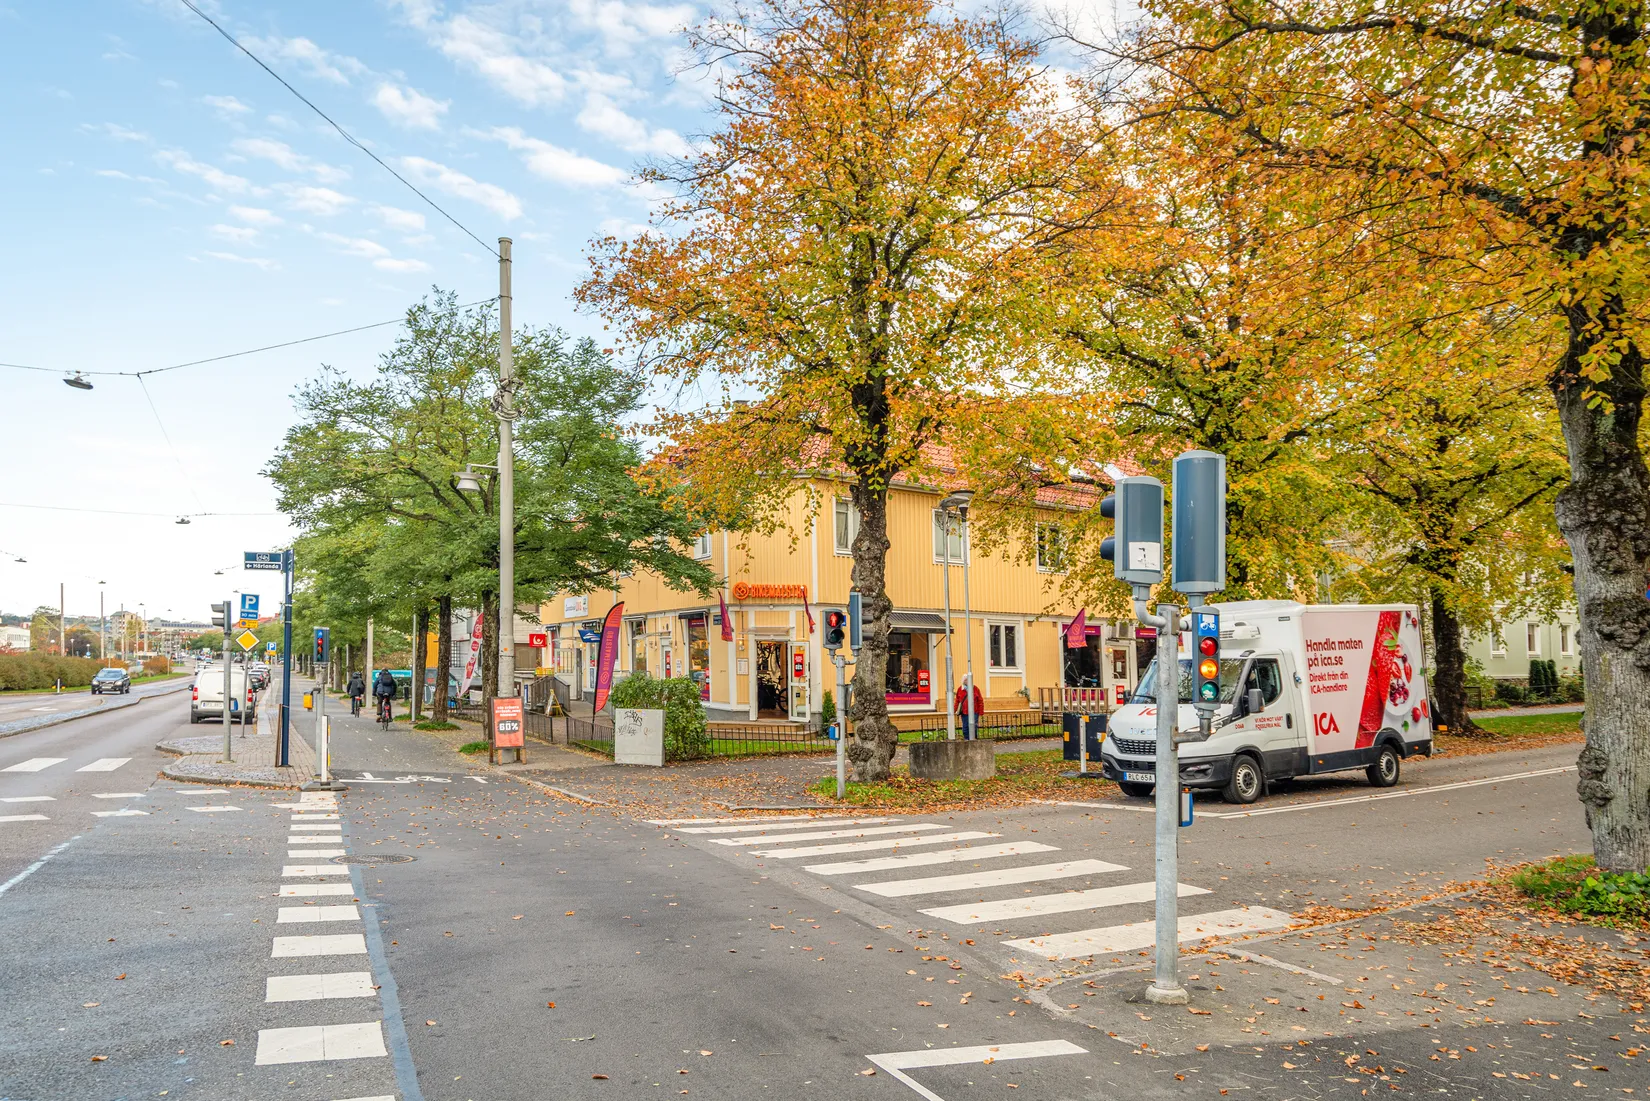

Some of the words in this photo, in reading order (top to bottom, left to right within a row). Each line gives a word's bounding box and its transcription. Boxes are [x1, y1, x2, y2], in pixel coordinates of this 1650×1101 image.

[245, 595, 257, 609] P
[1305, 638, 1337, 652] Handla
[1337, 638, 1364, 651] maten
[1307, 652, 1319, 670] på
[1320, 654, 1344, 667] ica.se
[1309, 673, 1327, 682] Direkt
[1327, 671, 1340, 681] från
[1340, 670, 1349, 680] din
[1310, 683, 1348, 694] ICA-handlare
[1138, 707, 1158, 716] IC
[499, 722, 519, 731] 60%
[1313, 711, 1340, 736] ICA
[1129, 727, 1157, 735] IVEC
[1140, 773, 1153, 781] 65A
